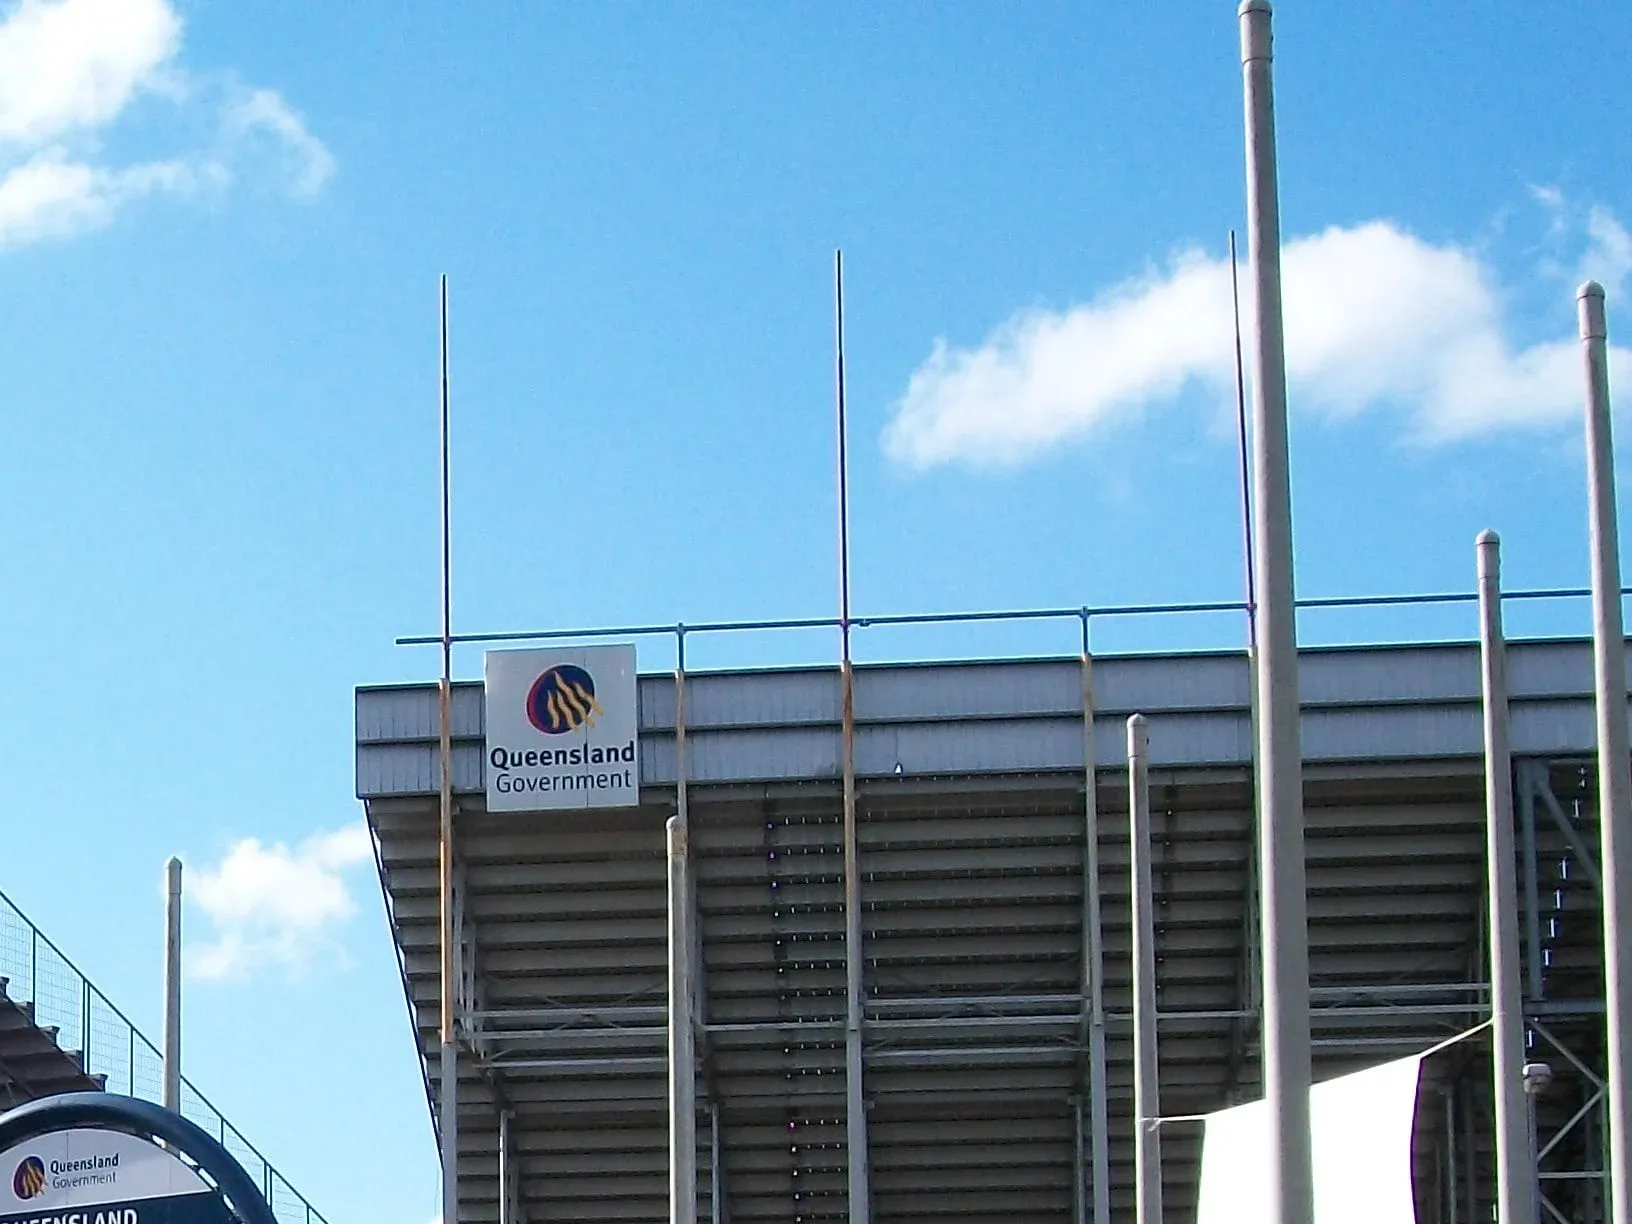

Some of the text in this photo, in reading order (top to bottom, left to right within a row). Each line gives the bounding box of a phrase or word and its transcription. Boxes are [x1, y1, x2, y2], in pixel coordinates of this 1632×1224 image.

[491, 741, 635, 769] Queensland
[496, 770, 631, 793] Government
[50, 1153, 120, 1175] Queensland
[52, 1172, 117, 1189] Government
